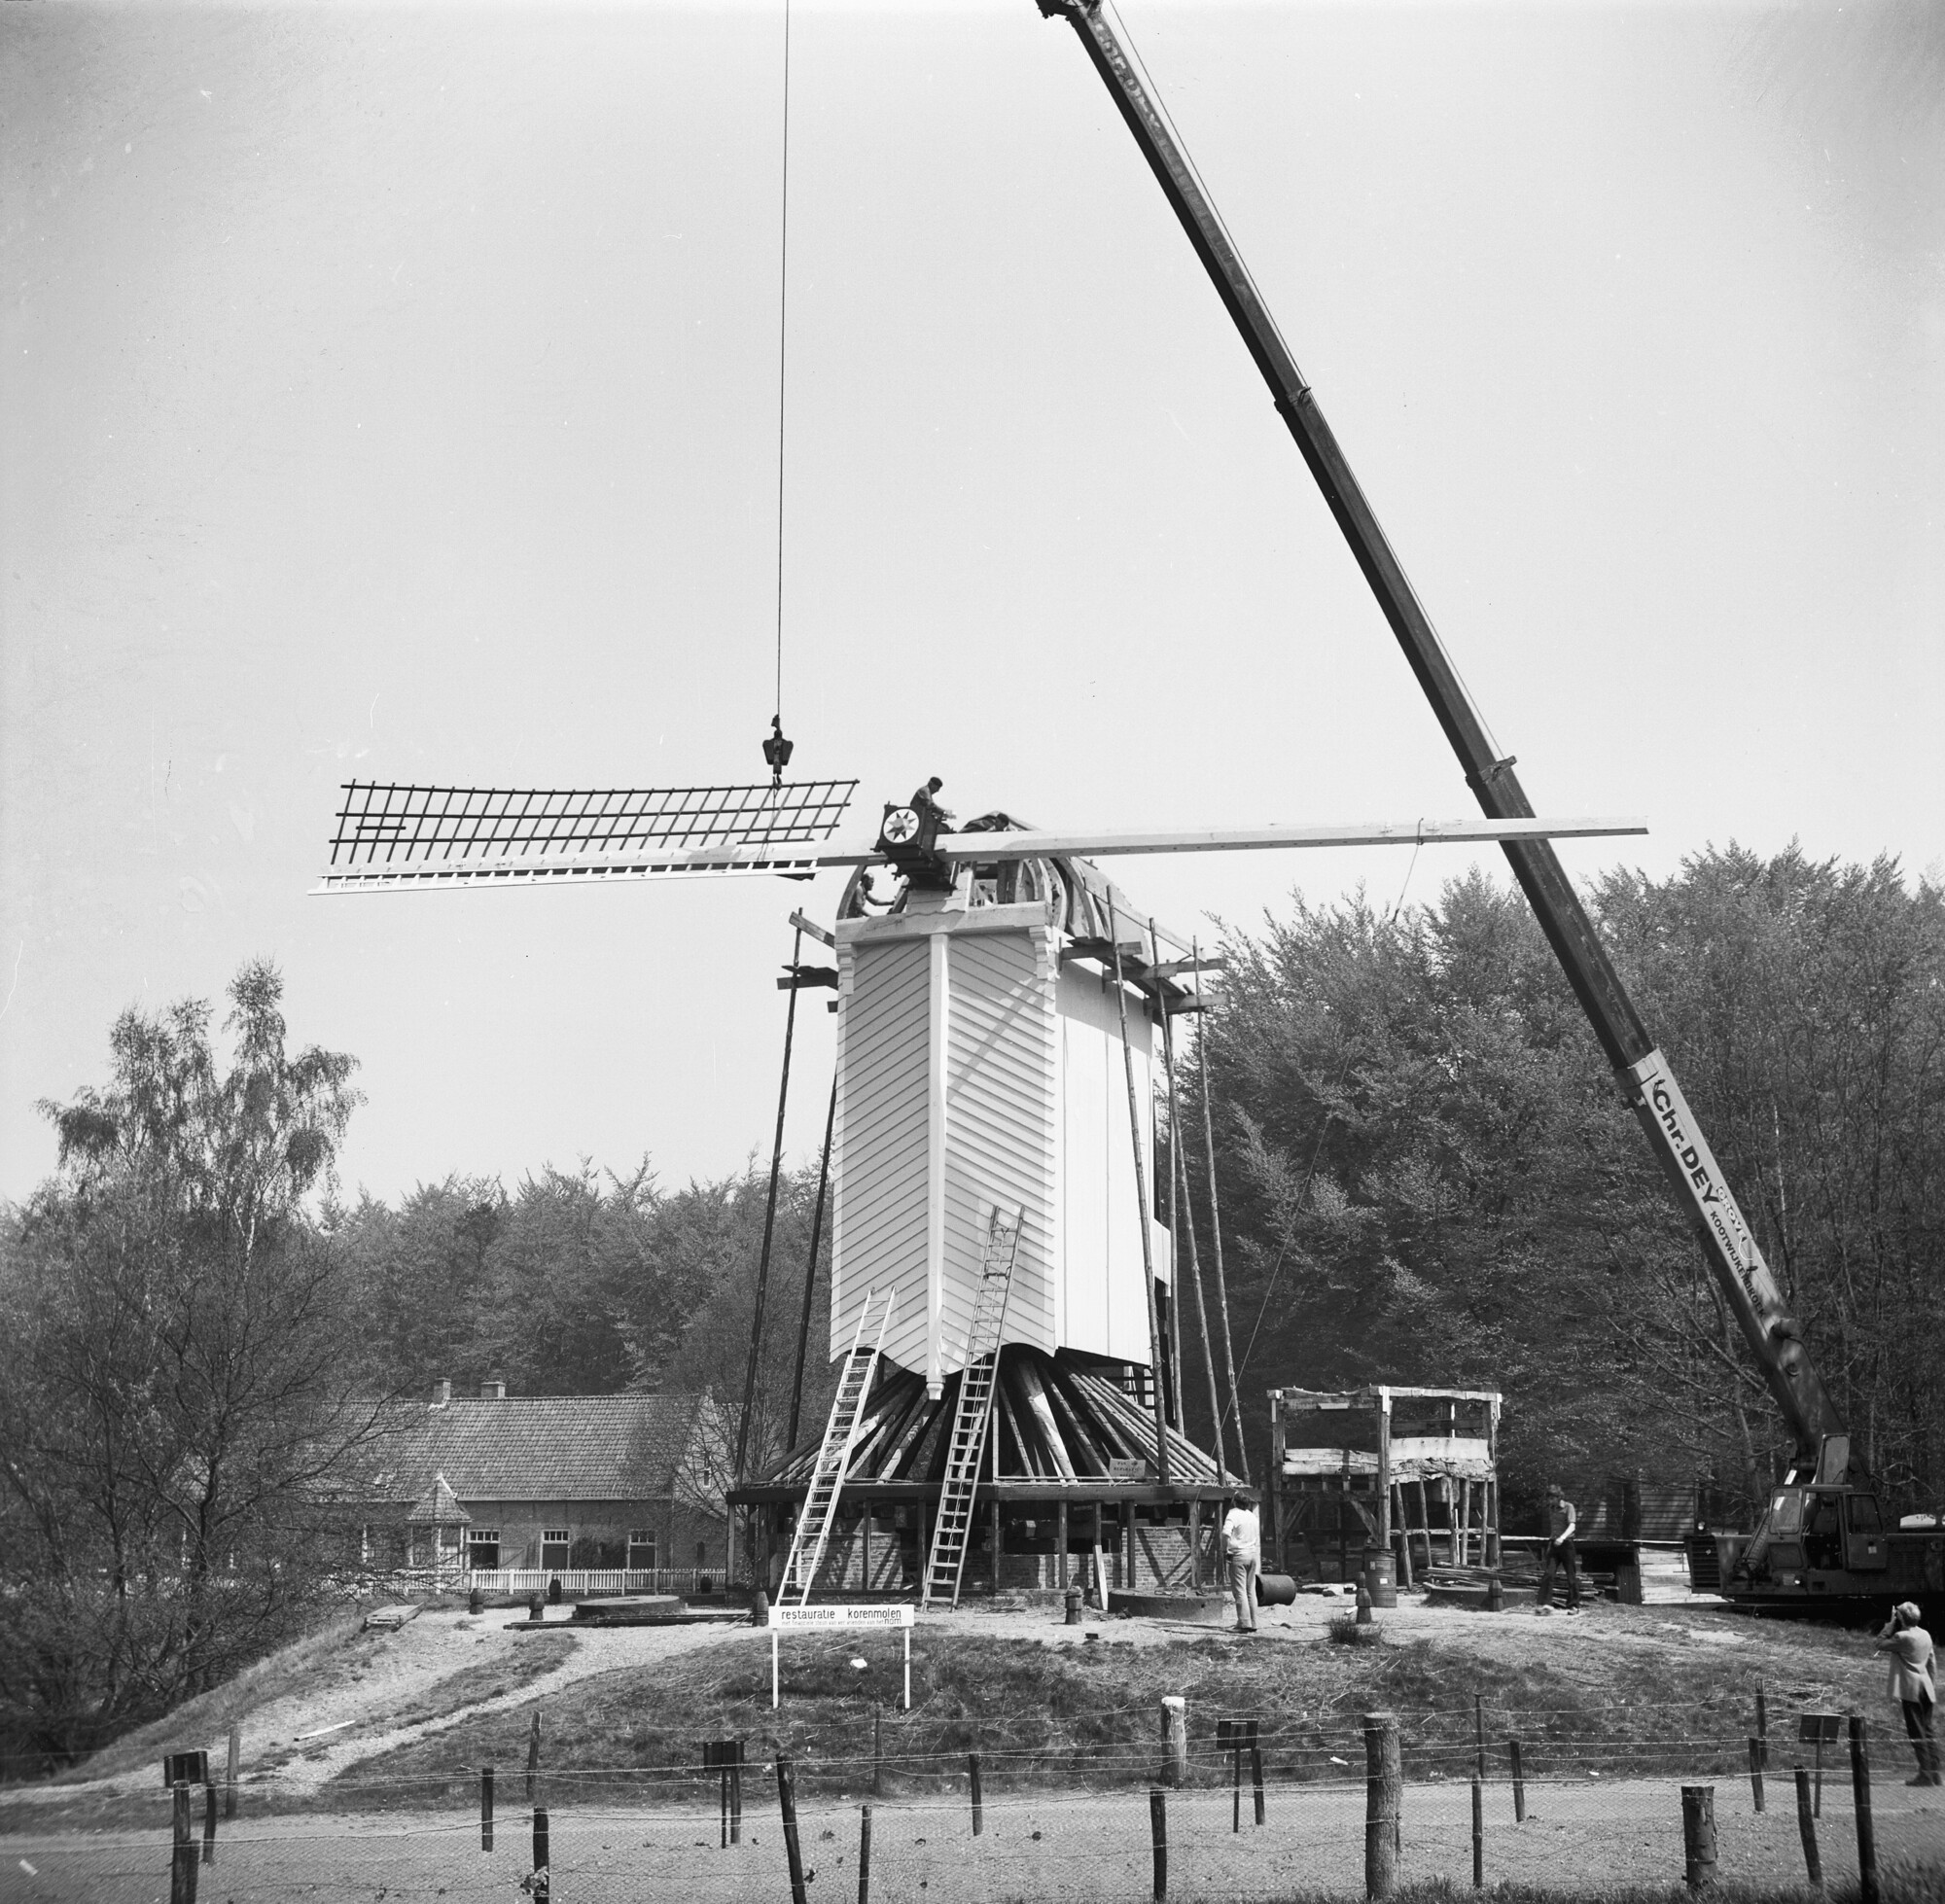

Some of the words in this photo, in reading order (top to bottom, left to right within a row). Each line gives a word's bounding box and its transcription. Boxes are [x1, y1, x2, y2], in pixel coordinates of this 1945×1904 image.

[1653, 1089, 1685, 1149] Chr.
[1680, 1146, 1720, 1207] DEY
[1715, 1186, 1747, 1241] GROVE
[1710, 1211, 1766, 1318] KOOTWIJKERBROEK
[781, 1609, 835, 1620] restauratie
[847, 1607, 902, 1618] korenmolen
